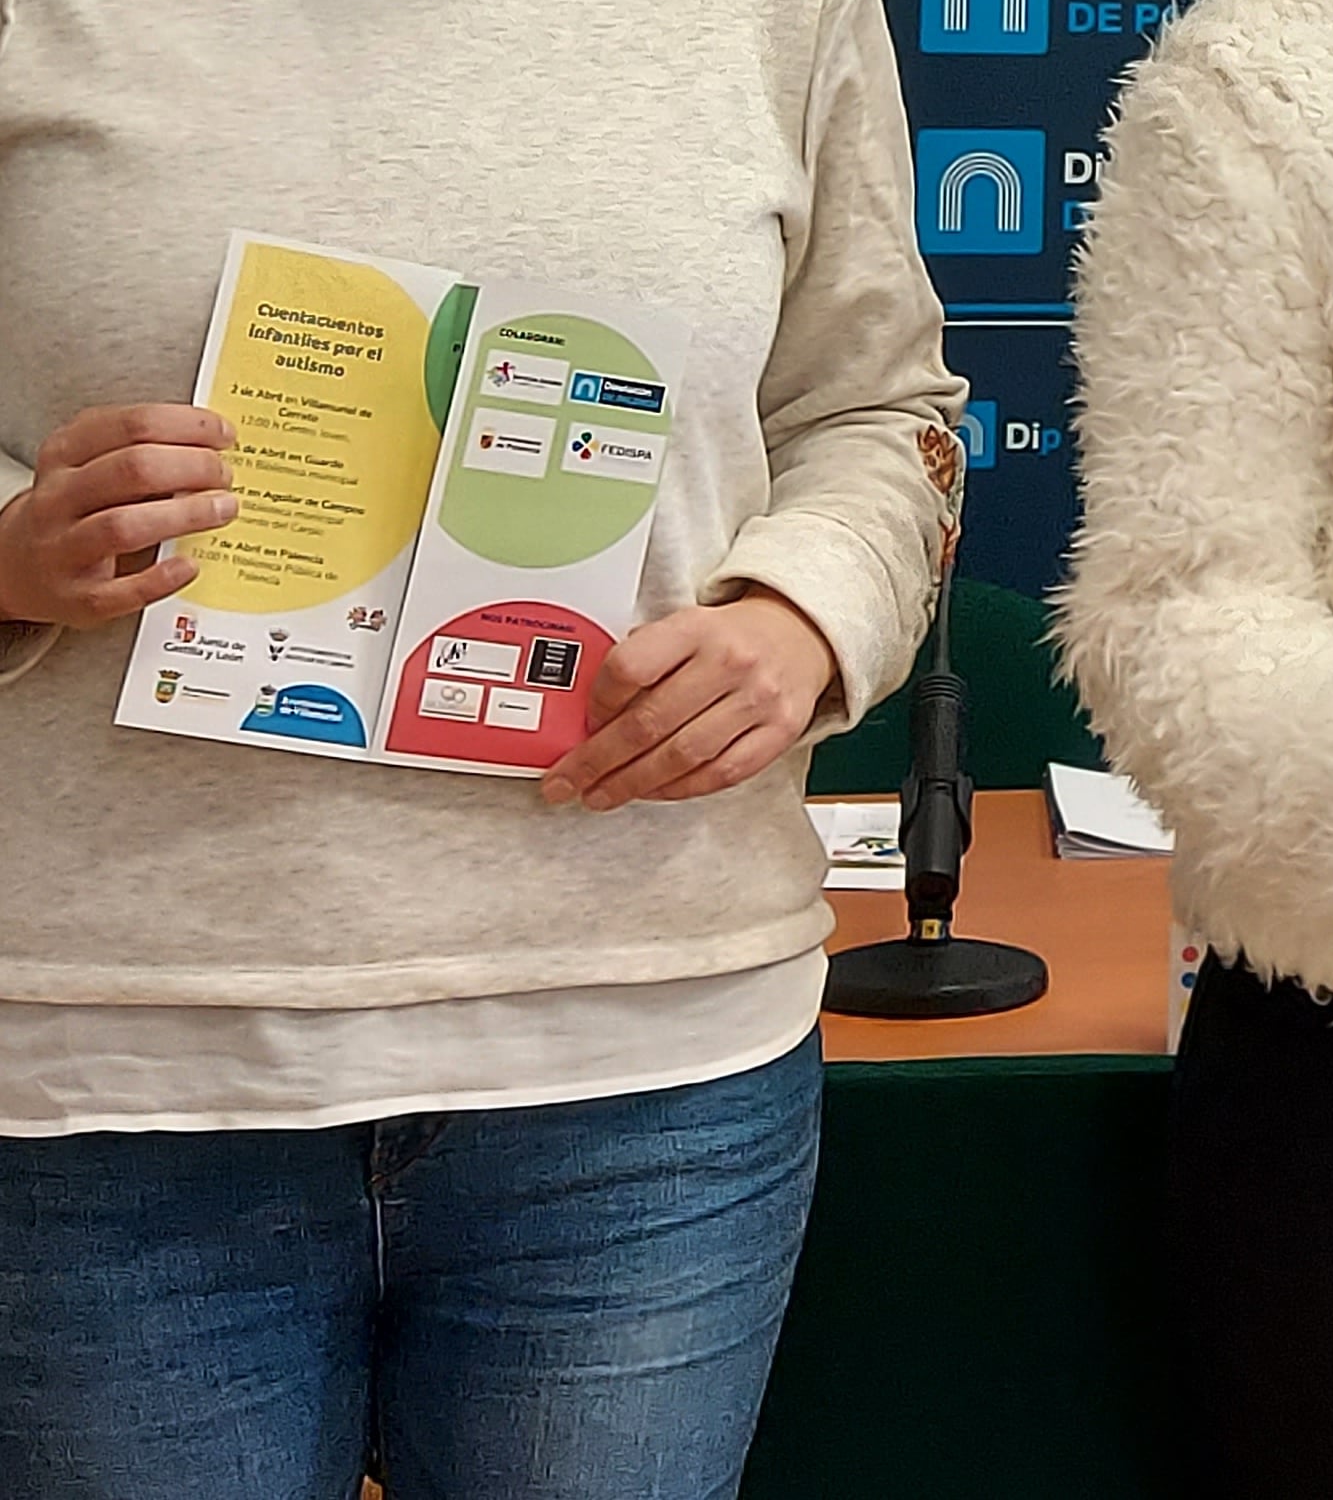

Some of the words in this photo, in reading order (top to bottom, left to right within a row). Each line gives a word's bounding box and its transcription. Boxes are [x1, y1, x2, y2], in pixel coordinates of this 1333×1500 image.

[1067, 2, 1122, 33] DE
[1064, 152, 1101, 184] Di
[257, 303, 384, 339] Cuentacuentos
[275, 353, 345, 377] autismo
[332, 342, 363, 358] por
[366, 347, 383, 361] el
[1006, 422, 1062, 457] Dip
